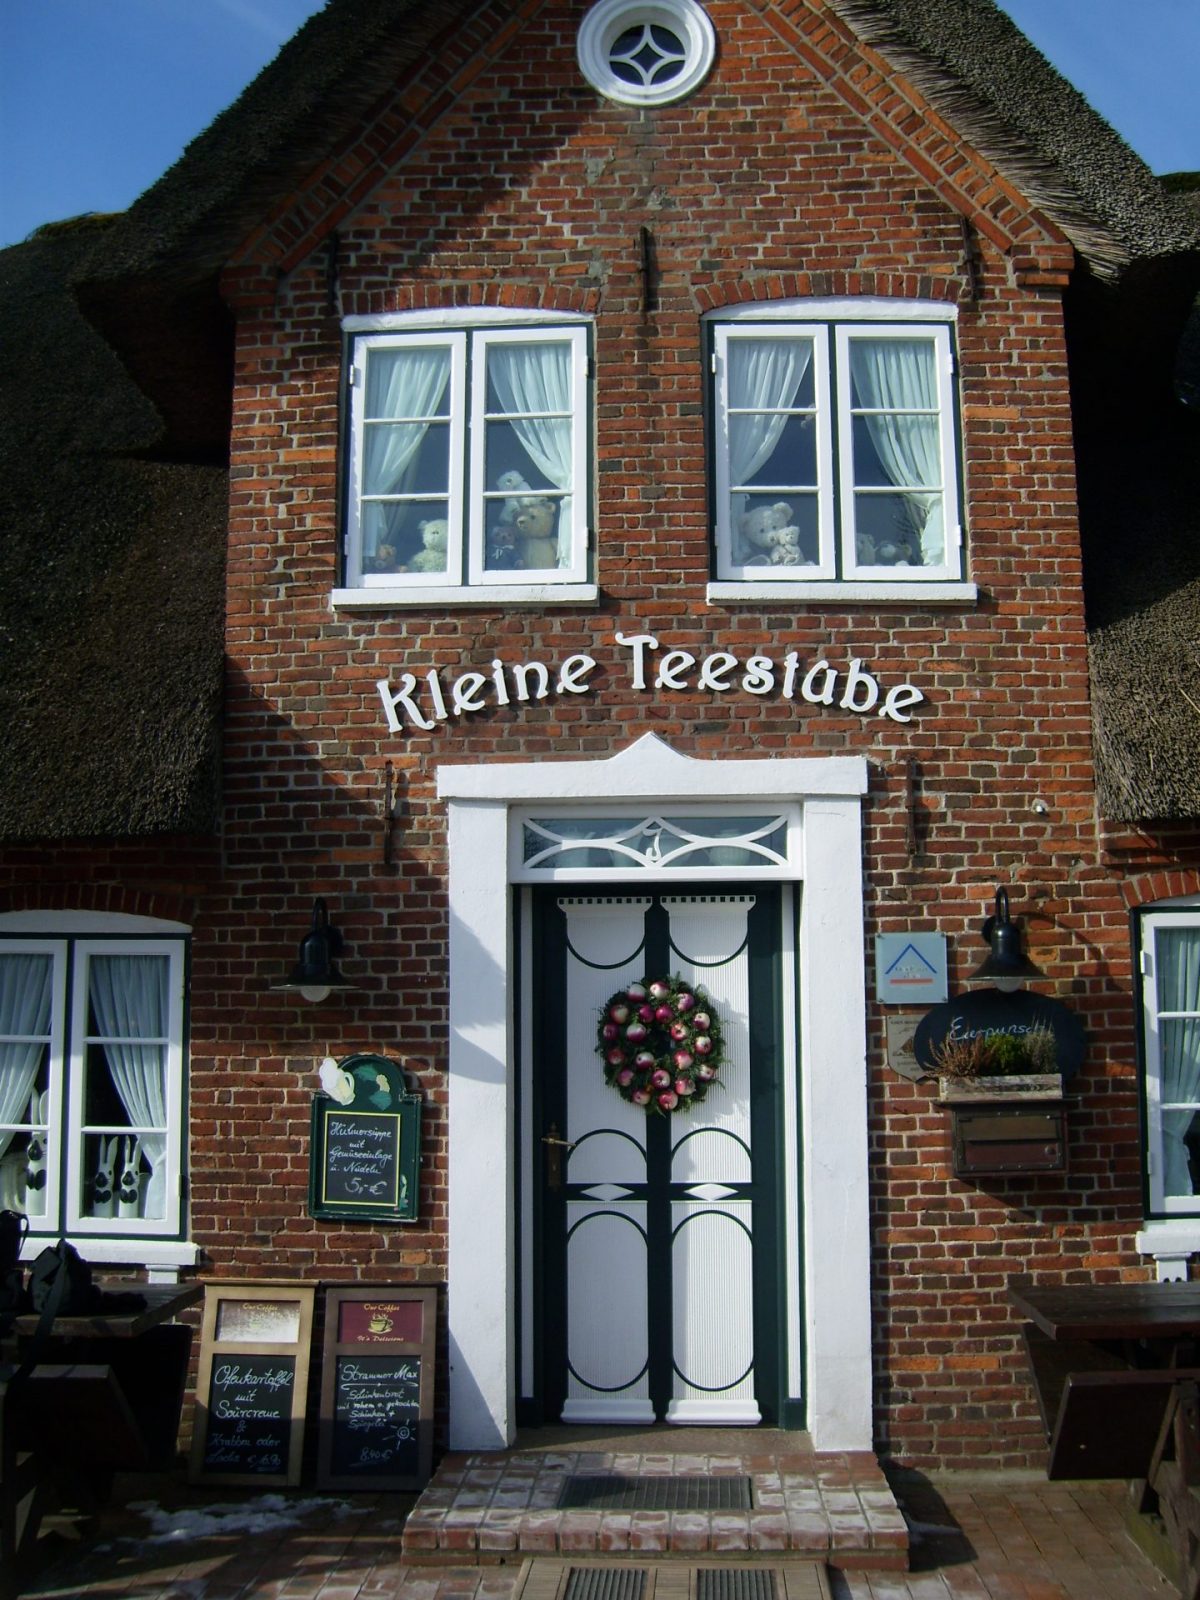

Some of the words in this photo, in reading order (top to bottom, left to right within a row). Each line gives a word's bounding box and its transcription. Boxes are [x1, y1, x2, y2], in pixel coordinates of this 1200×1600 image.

[376, 655, 596, 733] Kleine
[614, 632, 924, 723] Teestube
[364, 1303, 377, 1311] Our
[378, 1304, 400, 1312] Coffee
[341, 1364, 393, 1382] Strammer
[393, 1364, 418, 1381] Max
[234, 1389, 257, 1402] mit
